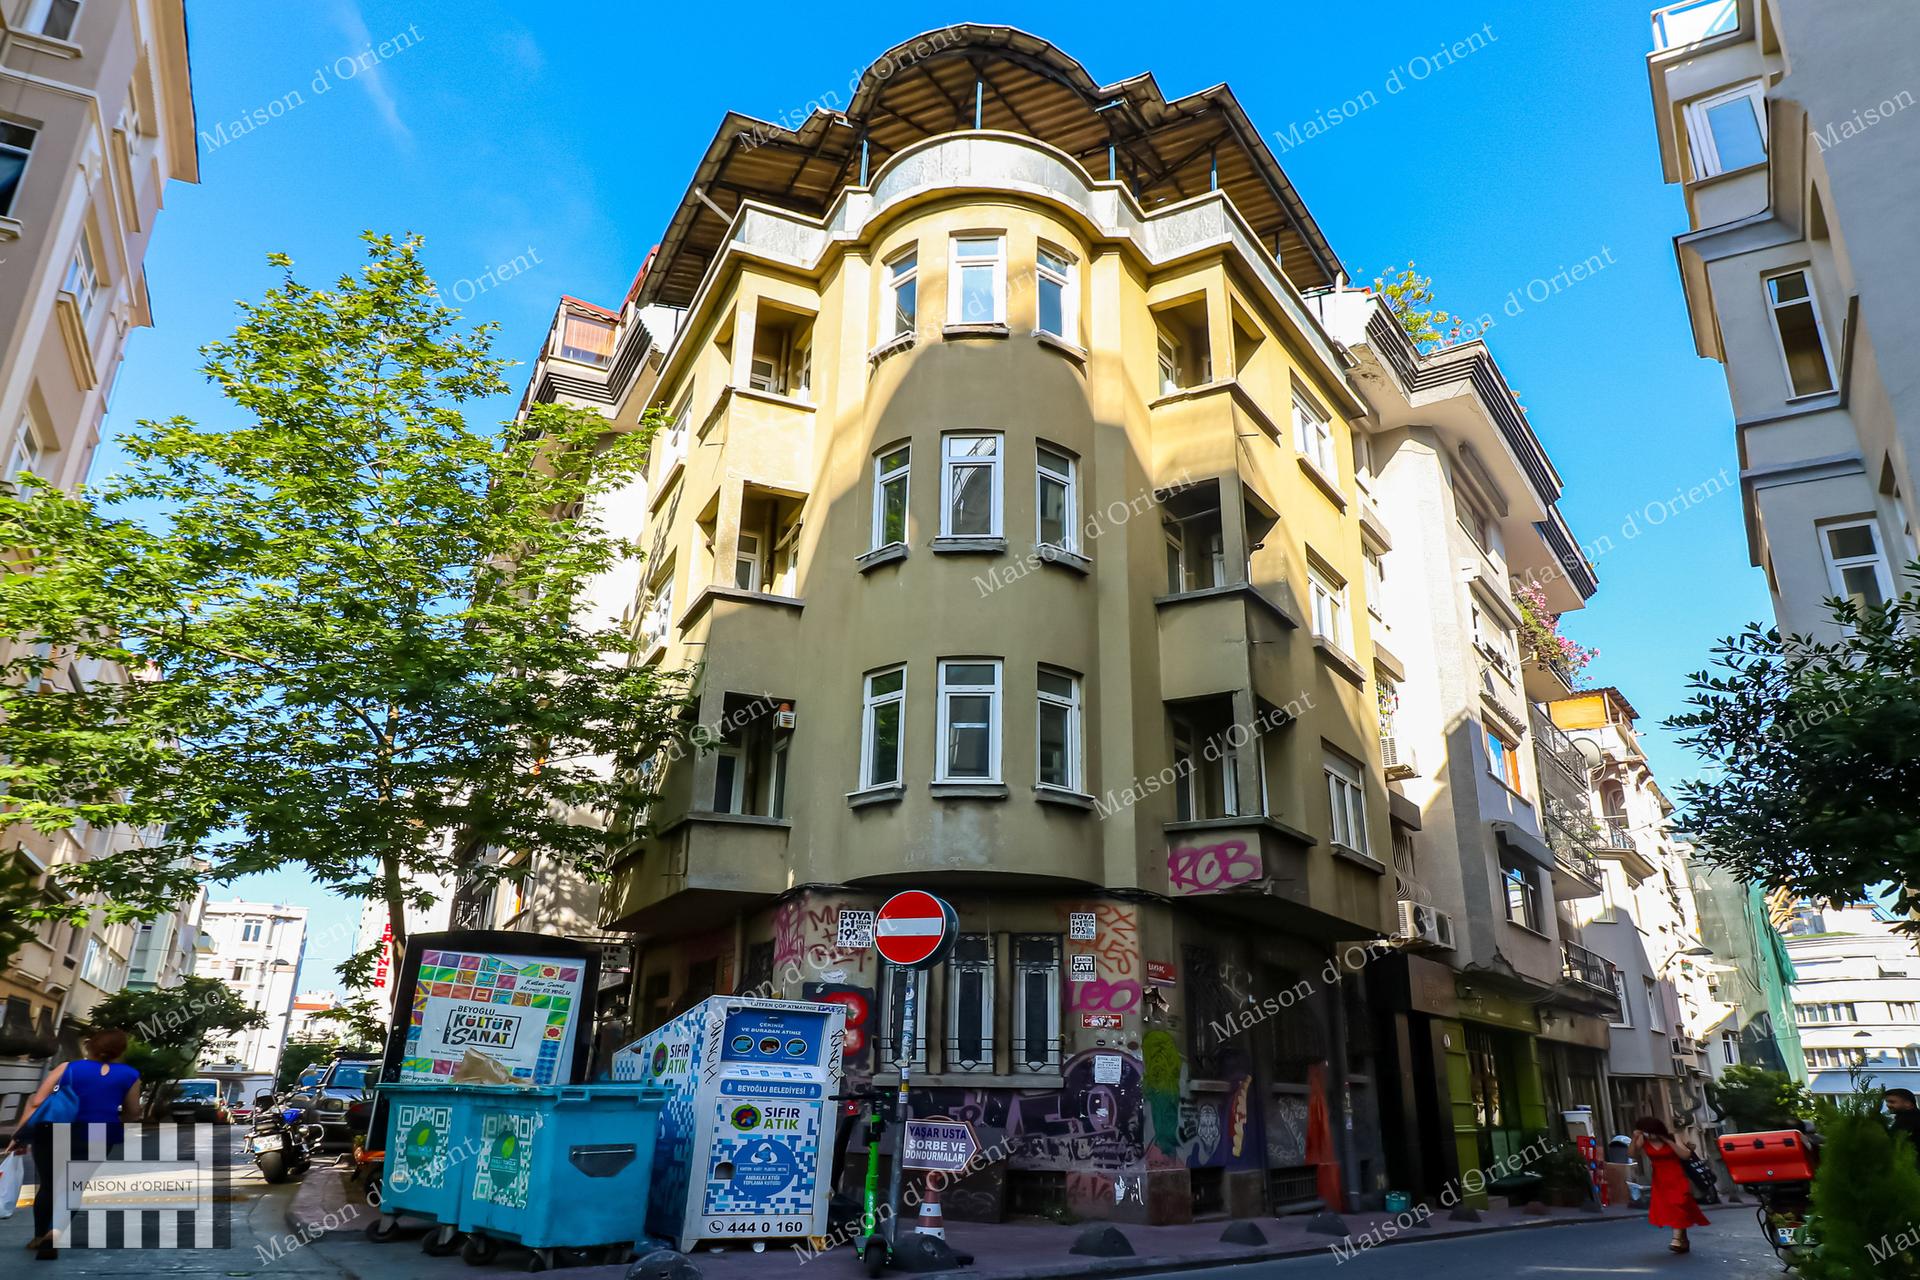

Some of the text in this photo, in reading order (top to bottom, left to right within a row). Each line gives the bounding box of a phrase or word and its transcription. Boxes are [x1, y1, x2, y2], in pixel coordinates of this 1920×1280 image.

[841, 912, 871, 920] BOYA
[840, 920, 855, 928] 1+1
[840, 929, 858, 940] 195
[453, 1014, 513, 1031] KÜLTÜR
[450, 1028, 510, 1045] SANAT
[670, 1043, 689, 1058] SIFIR
[667, 1059, 687, 1073] ATIK
[769, 1085, 806, 1095] BELEDİYESİ
[764, 1107, 800, 1118] SIFIR
[763, 1118, 799, 1130] ATIK
[909, 1126, 967, 1140] YAŞAR USTA
[909, 1139, 966, 1152] SORBE VE
[905, 1150, 966, 1163] DONDURMALARI
[728, 1222, 803, 1233] 444 0 160
